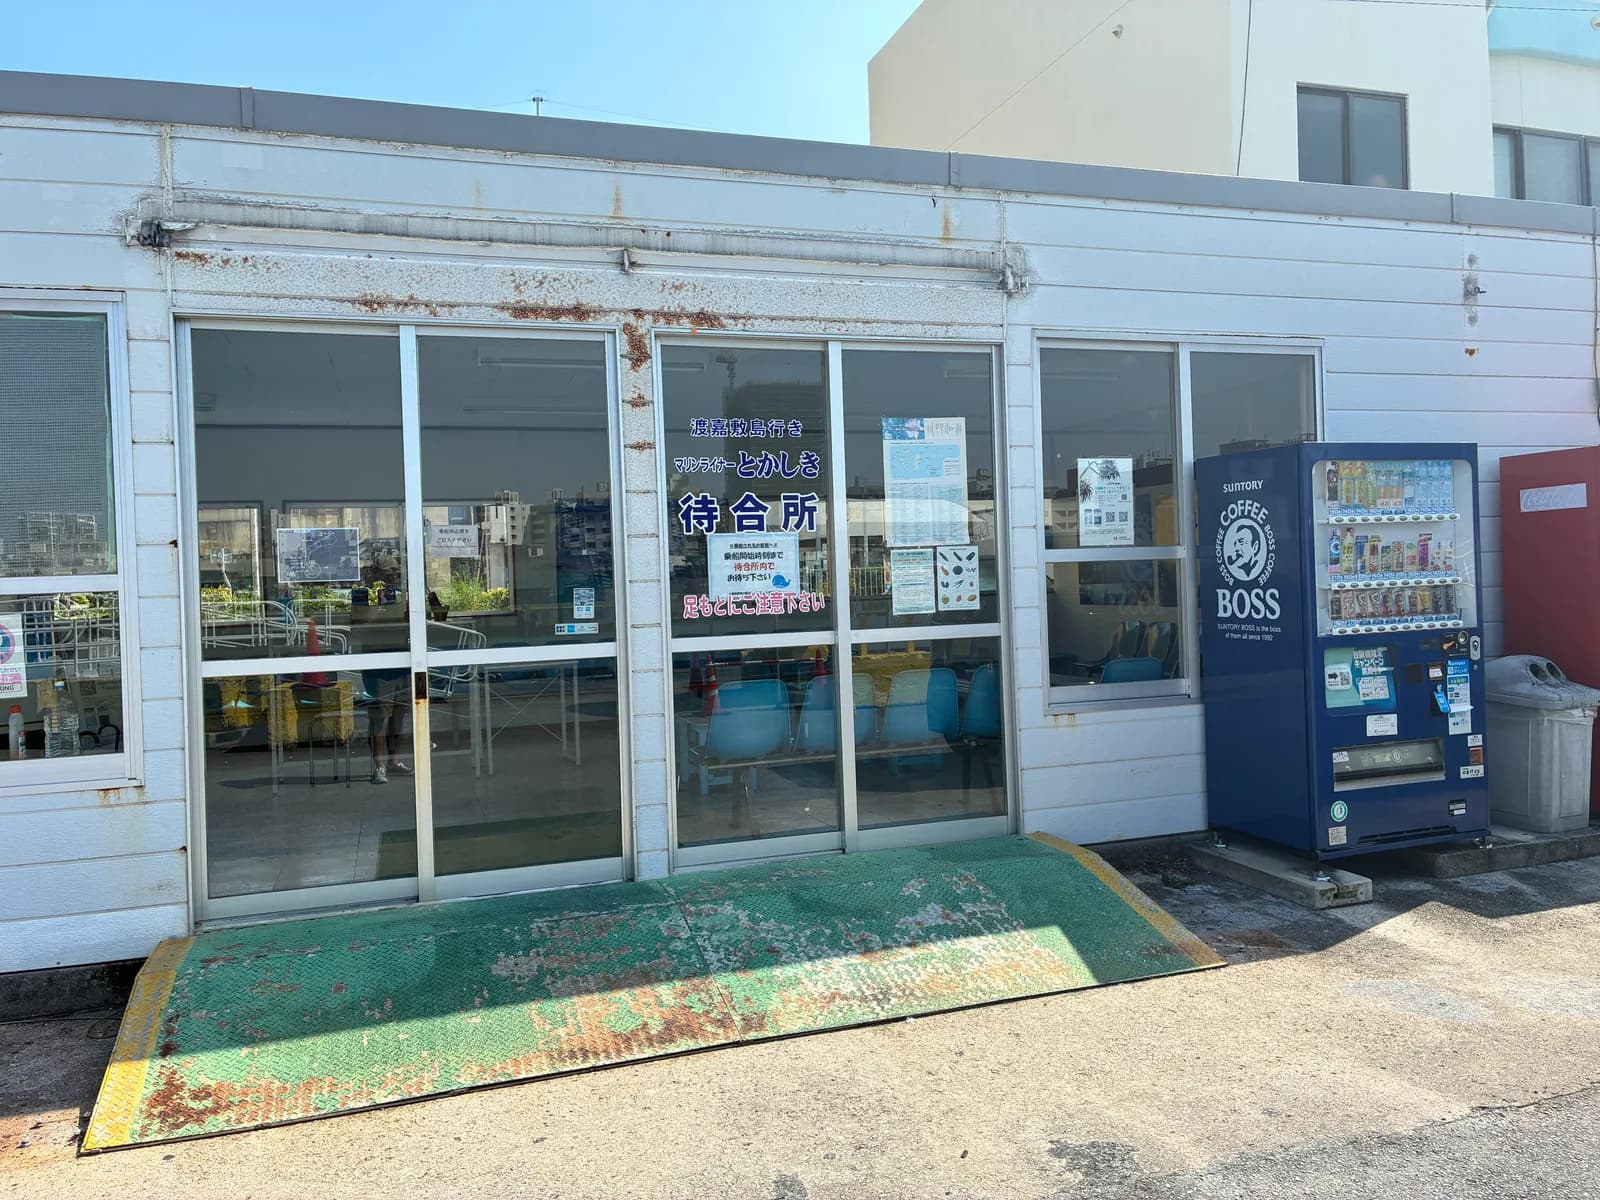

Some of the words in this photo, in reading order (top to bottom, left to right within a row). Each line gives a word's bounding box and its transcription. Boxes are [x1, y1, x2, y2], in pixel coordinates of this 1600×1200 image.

[690, 418, 803, 438] 渡嘉敷島行き
[678, 491, 820, 534] 待合所
[1220, 500, 1269, 527] COFFEE
[1215, 527, 1225, 563] COFFEE
[1264, 524, 1276, 550] BOSS
[727, 573, 771, 582] お待ち下さい
[734, 562, 775, 571] 待合所内で
[1218, 564, 1234, 586] BOSS
[1258, 552, 1276, 586] COFFEE
[683, 591, 826, 619] 足もとにご注意下さい
[1216, 588, 1281, 620] BOSS
